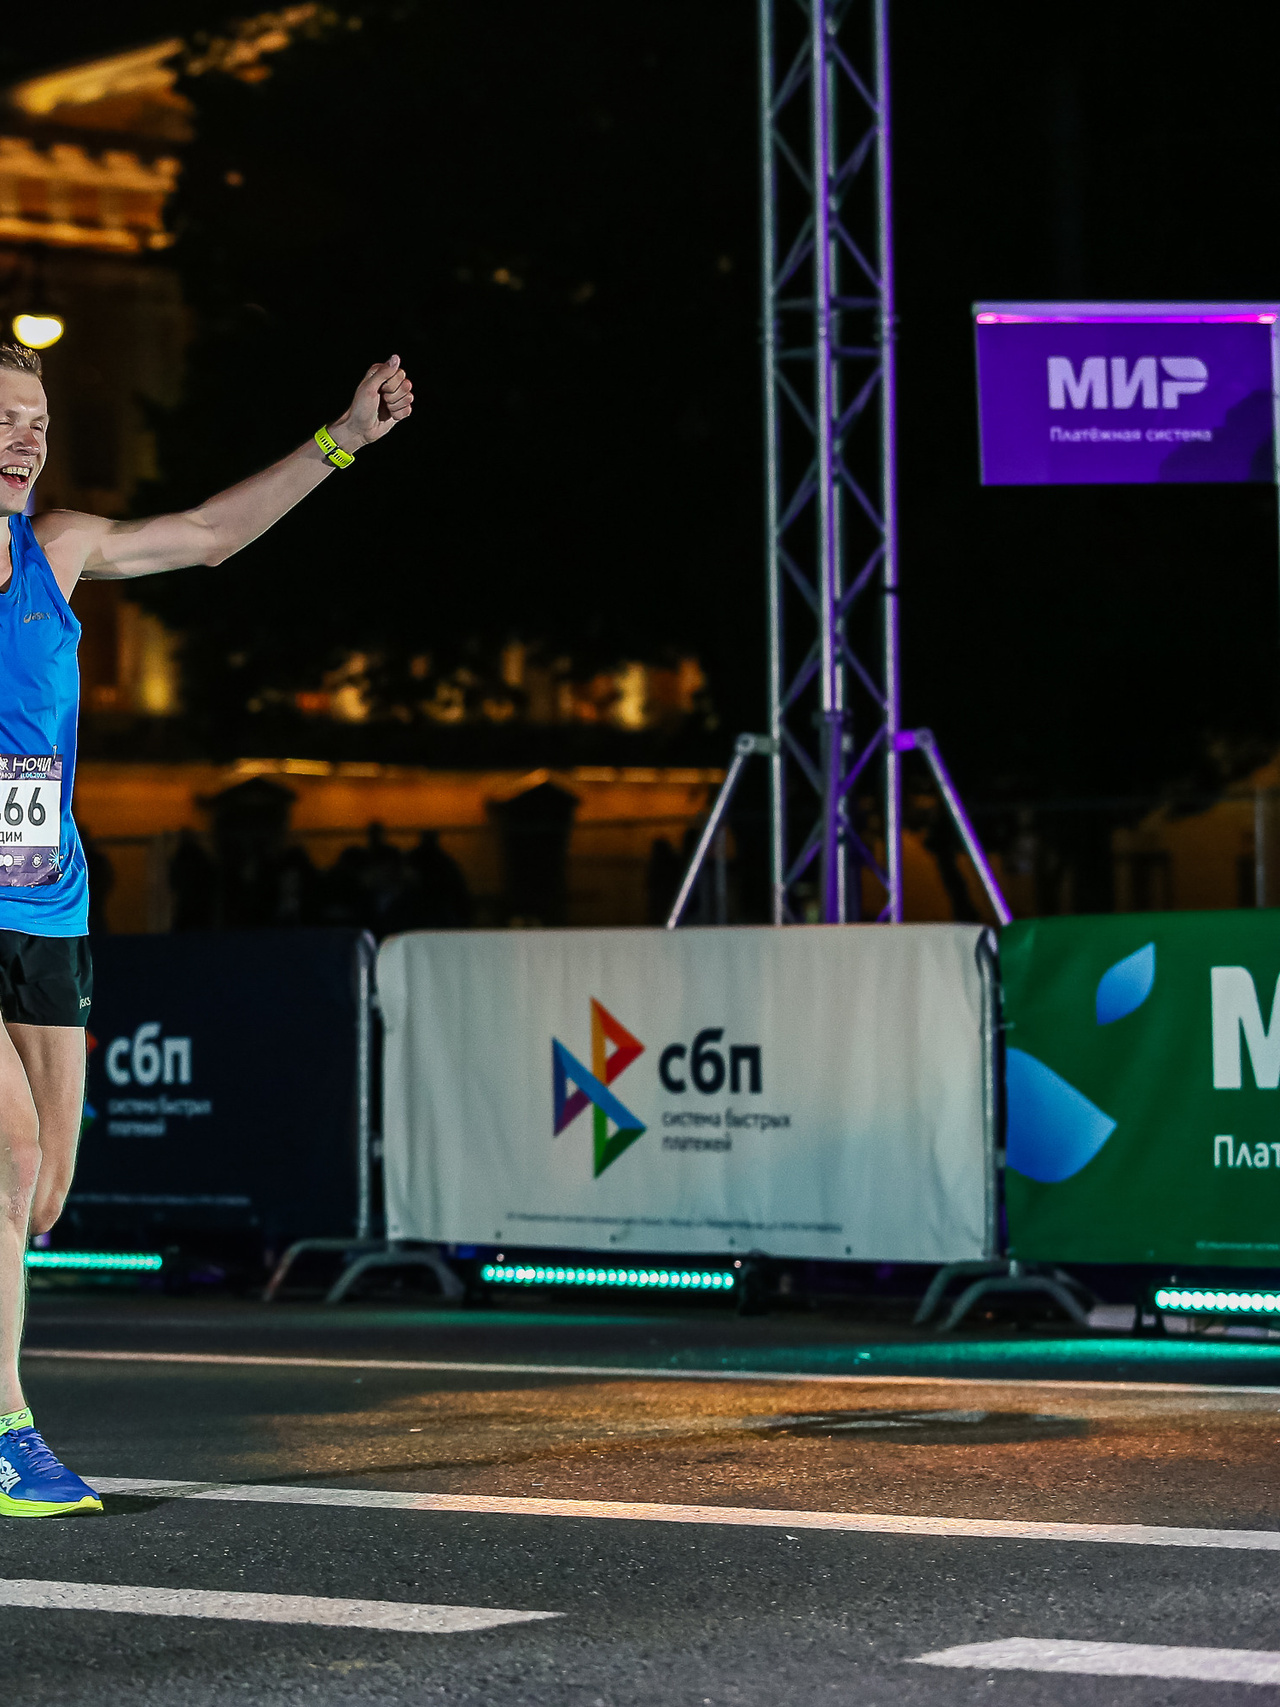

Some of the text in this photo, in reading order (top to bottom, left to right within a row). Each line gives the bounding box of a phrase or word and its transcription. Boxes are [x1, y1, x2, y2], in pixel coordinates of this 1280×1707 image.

[1047, 355, 1209, 410] МИР
[13, 757, 52, 772] НОЧИ
[106, 1021, 191, 1086] сбп
[658, 1026, 762, 1095] сбп
